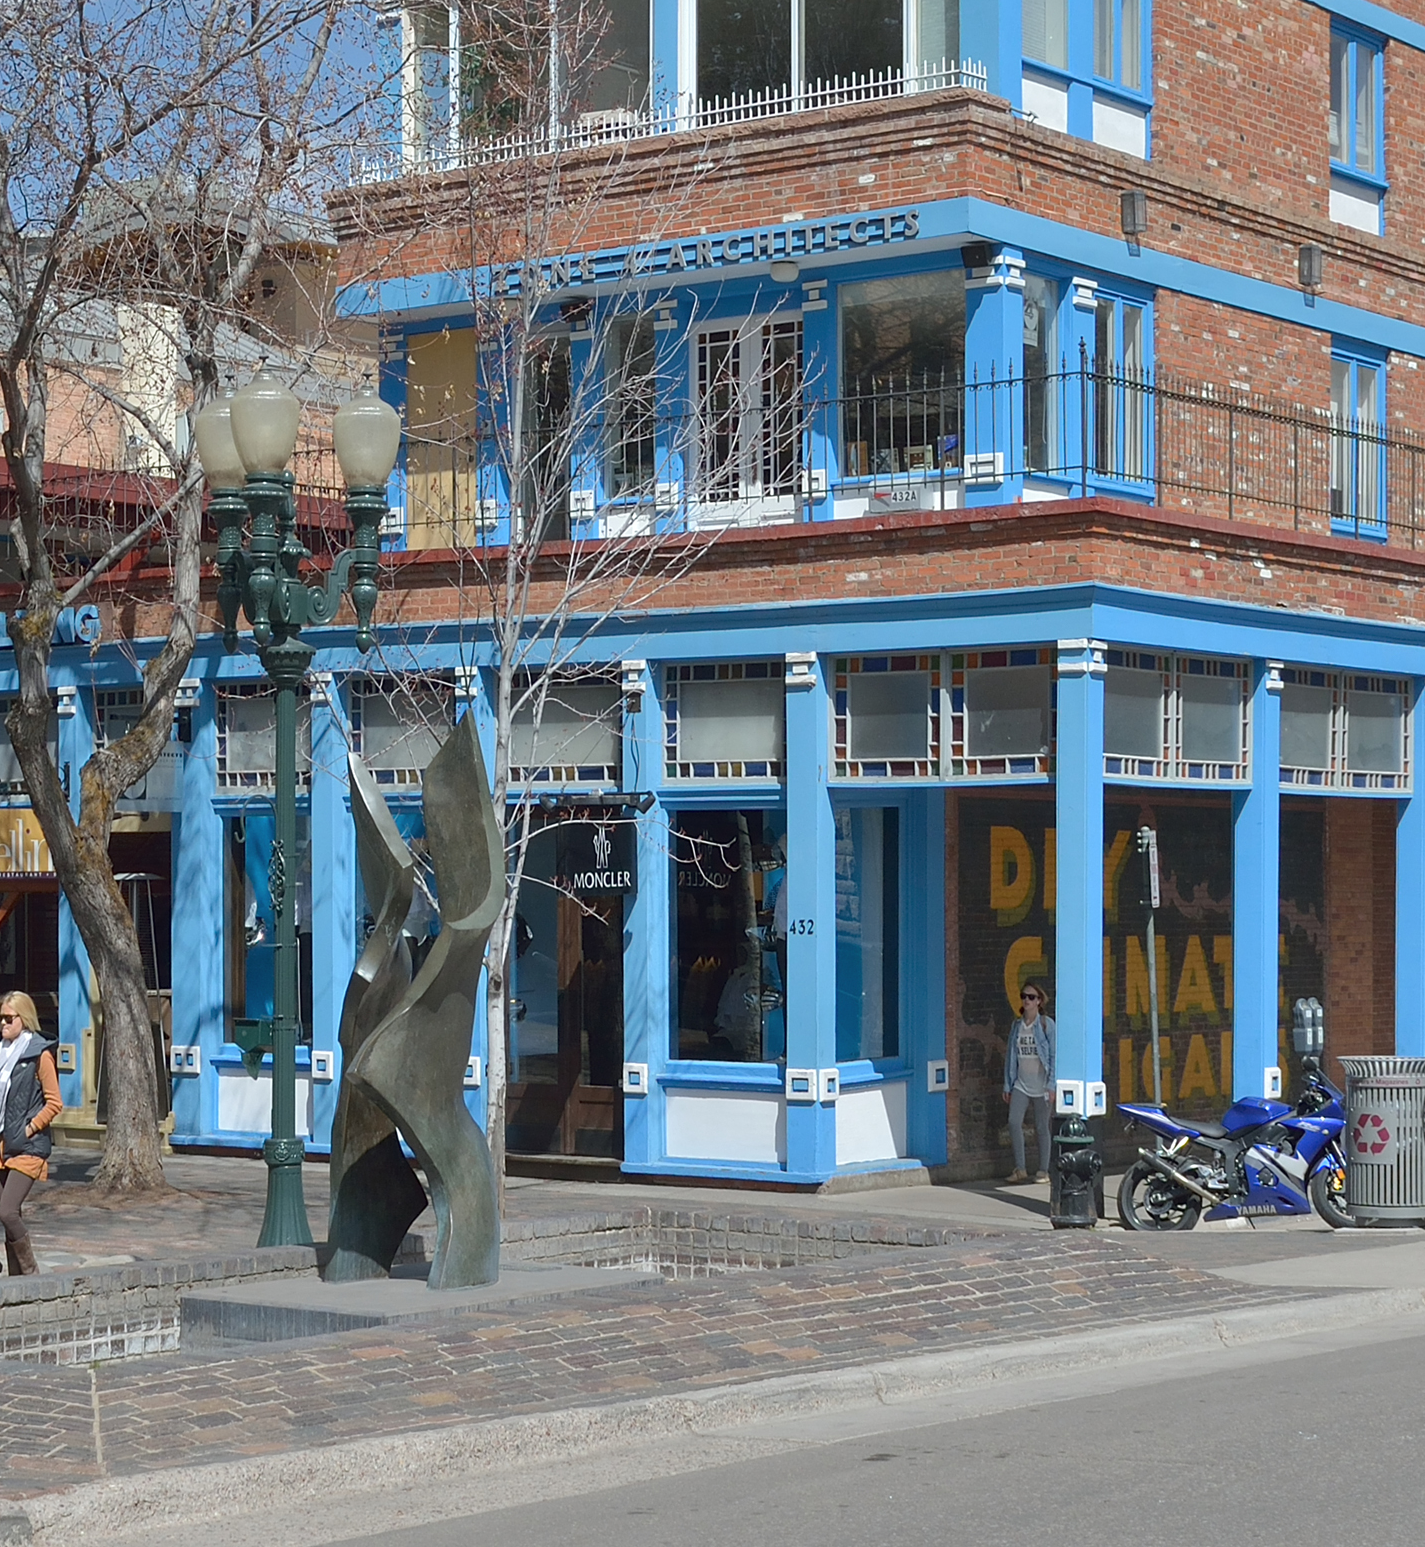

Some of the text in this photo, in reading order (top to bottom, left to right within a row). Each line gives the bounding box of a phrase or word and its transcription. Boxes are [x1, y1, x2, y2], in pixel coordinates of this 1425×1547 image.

[666, 209, 920, 270] ARCHITECTS
[892, 491, 917, 502] 432A
[574, 871, 632, 889] MONCLER
[789, 919, 815, 935] 432
[1375, 1078, 1409, 1086] Magazines
[1236, 1205, 1277, 1215] YAMAHA
